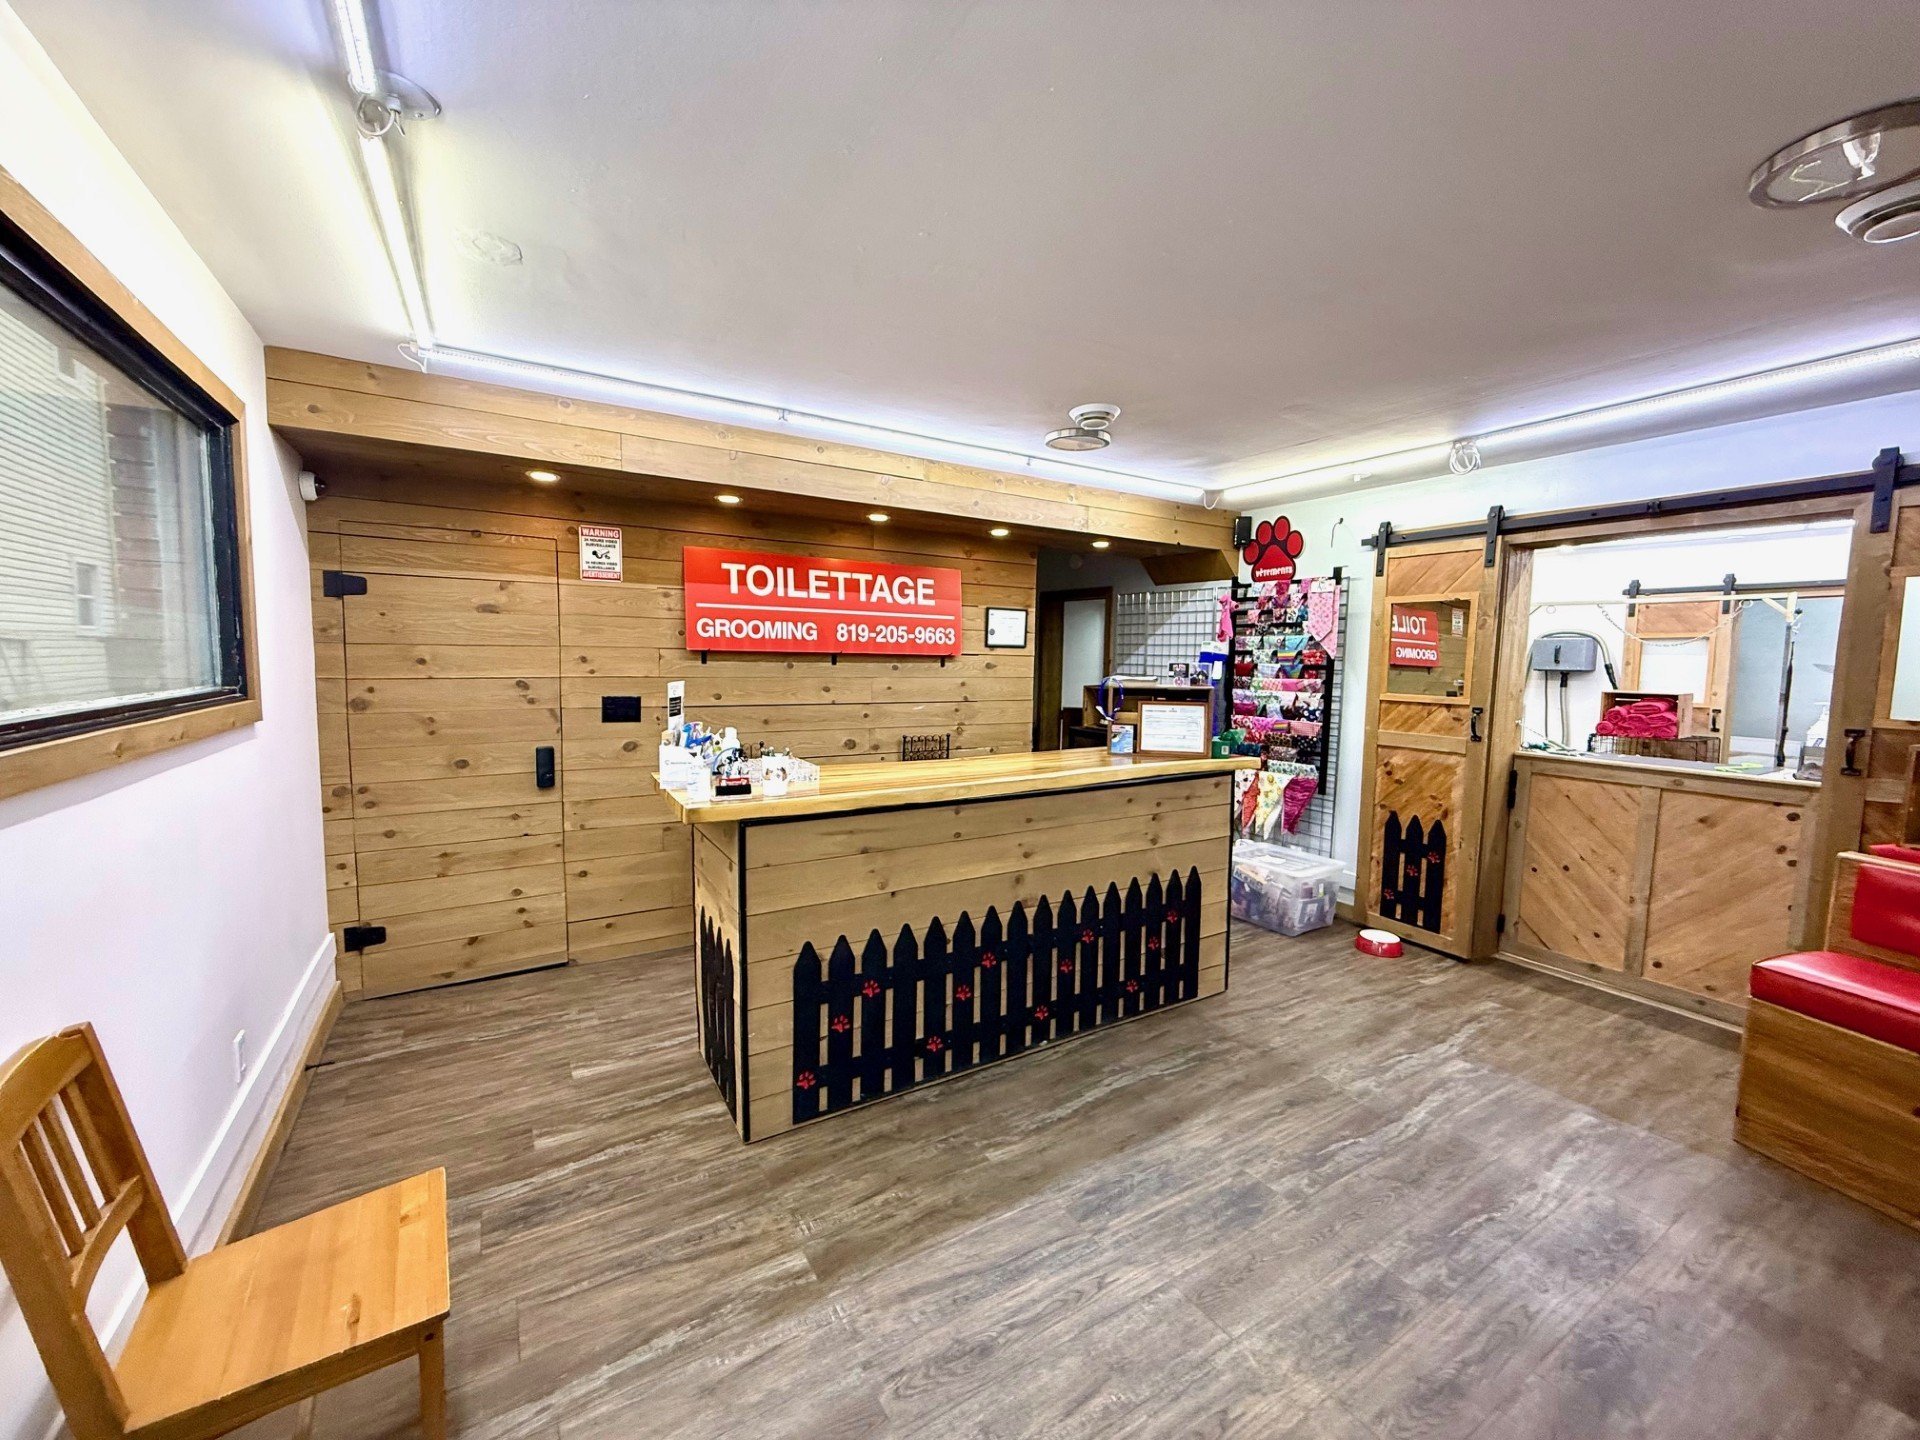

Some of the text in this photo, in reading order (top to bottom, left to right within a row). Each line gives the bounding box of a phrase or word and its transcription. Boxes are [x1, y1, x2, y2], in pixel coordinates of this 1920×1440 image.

[582, 528, 619, 538] WARNING
[721, 562, 936, 606] TOILETTAGE
[696, 617, 956, 645] GROOMING 819-205-9663
